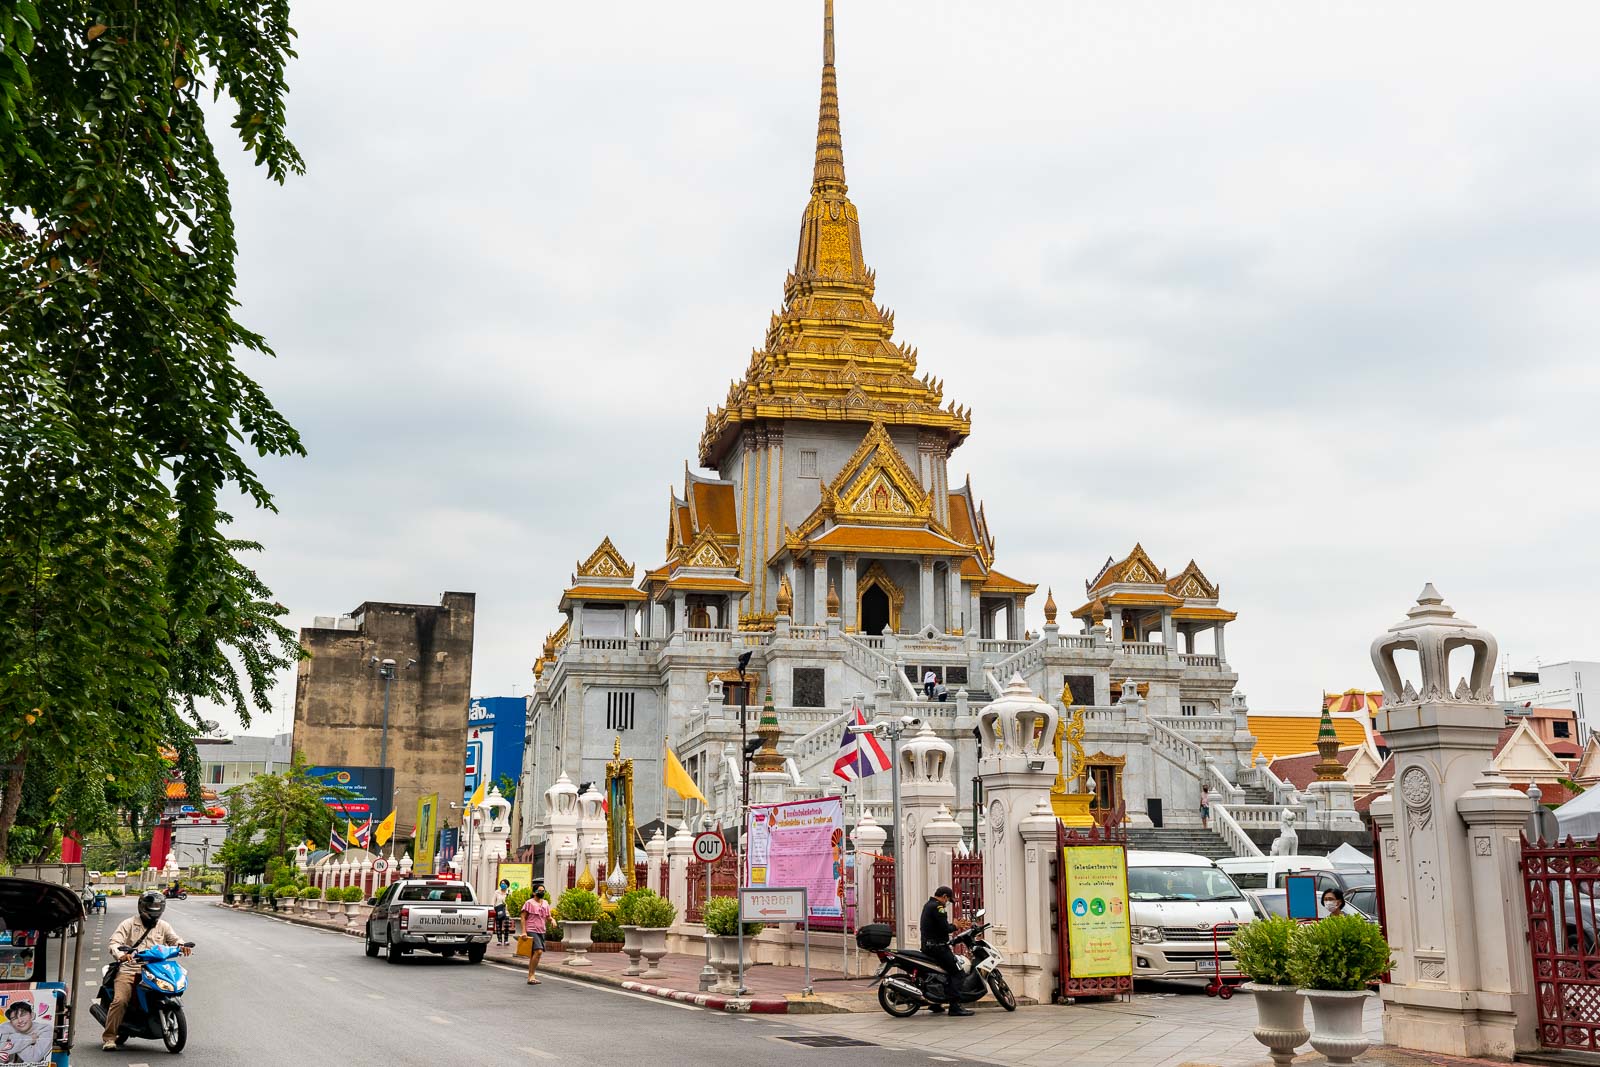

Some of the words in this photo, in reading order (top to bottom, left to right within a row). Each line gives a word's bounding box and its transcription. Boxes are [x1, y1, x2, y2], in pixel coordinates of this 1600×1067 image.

[699, 840, 720, 854] OUT
[751, 895, 794, 905] ทางออก
[471, 917, 477, 925] 2
